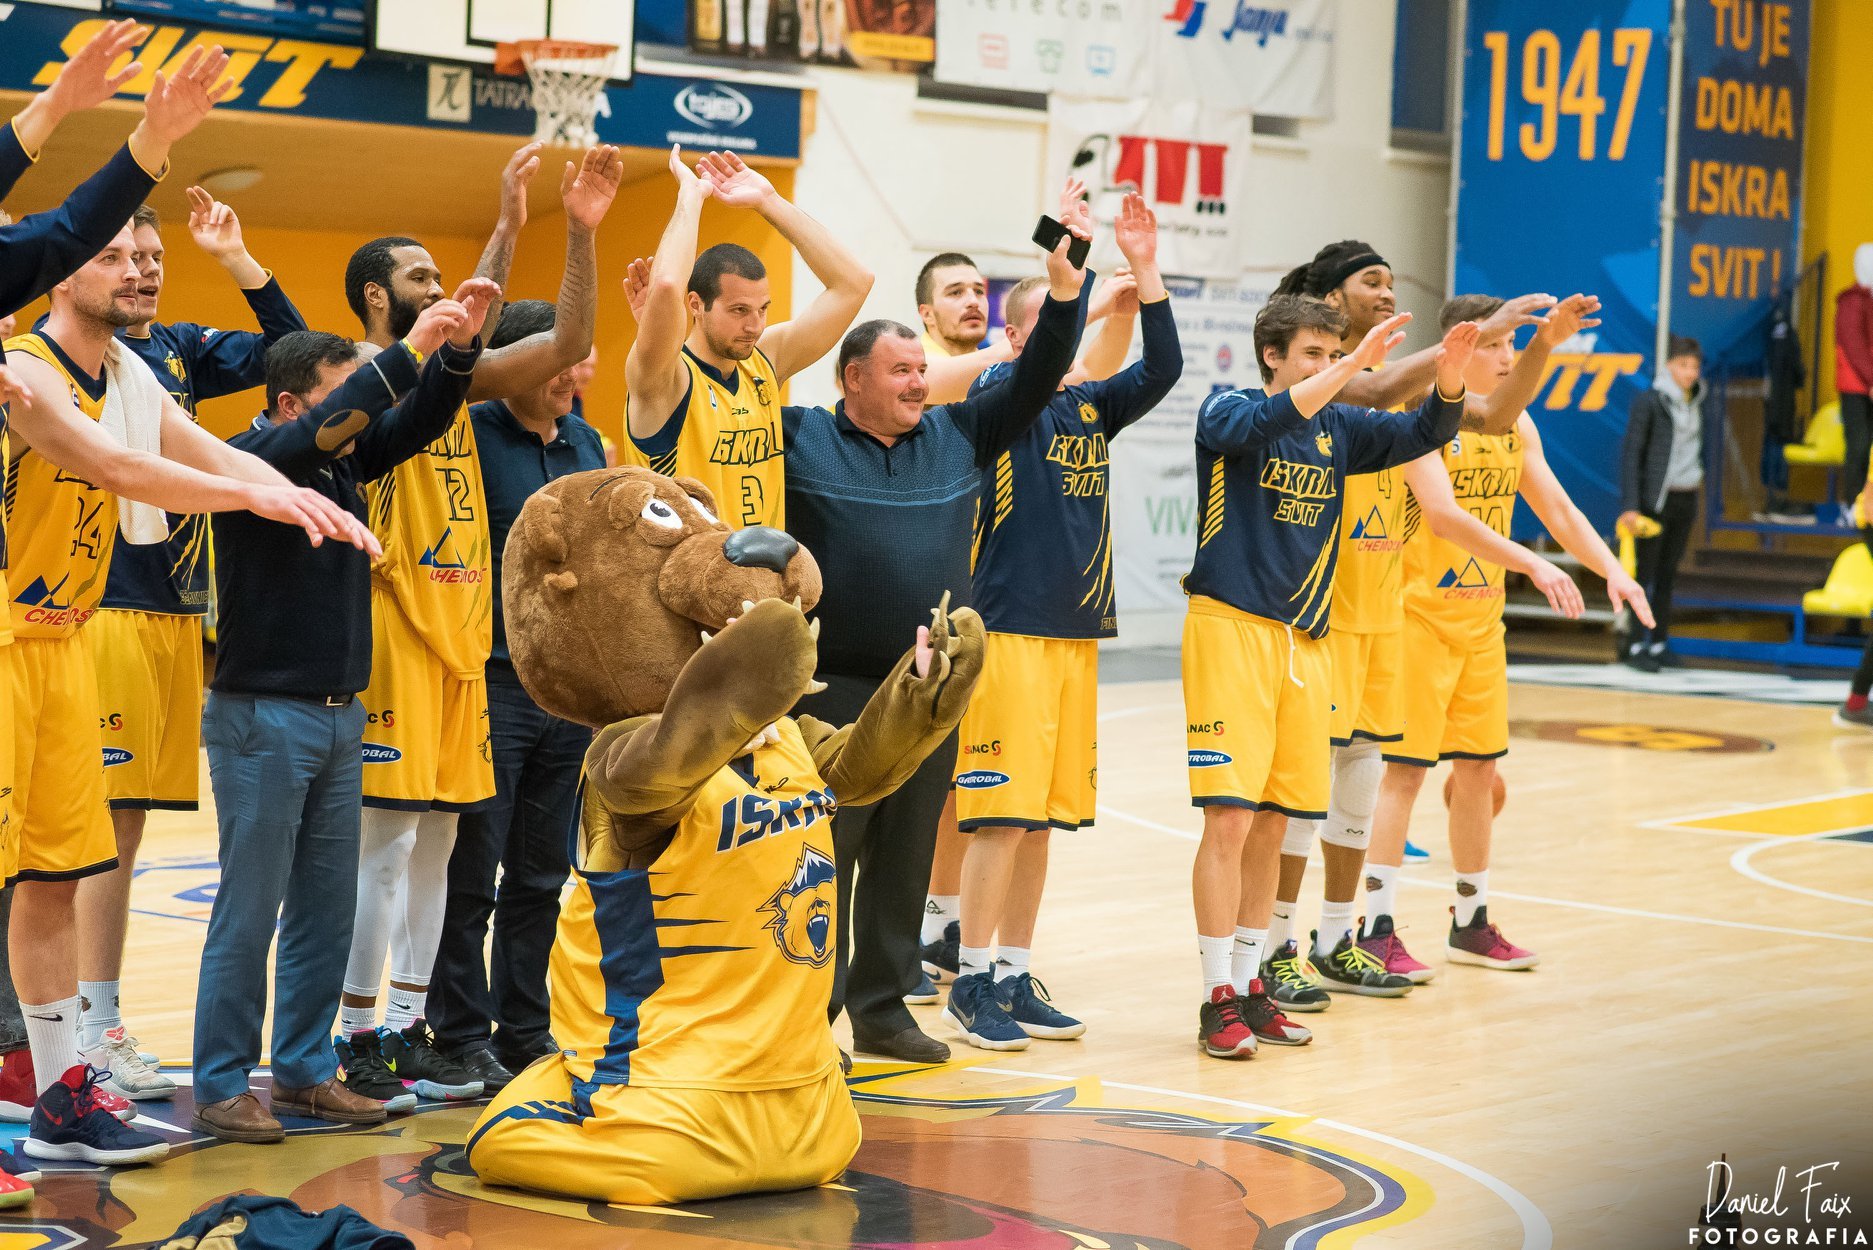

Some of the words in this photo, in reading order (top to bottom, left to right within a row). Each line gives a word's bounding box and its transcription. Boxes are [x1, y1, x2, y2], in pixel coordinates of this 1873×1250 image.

[1711, 0, 1754, 51] TU
[1759, 4, 1790, 67] JE
[1484, 28, 1653, 161] 1947
[1695, 77, 1794, 140] DOMA
[1687, 160, 1791, 220] ISKRA
[1688, 244, 1765, 299] SVIT
[741, 474, 764, 527] 3
[1259, 457, 1337, 500] ISKRA
